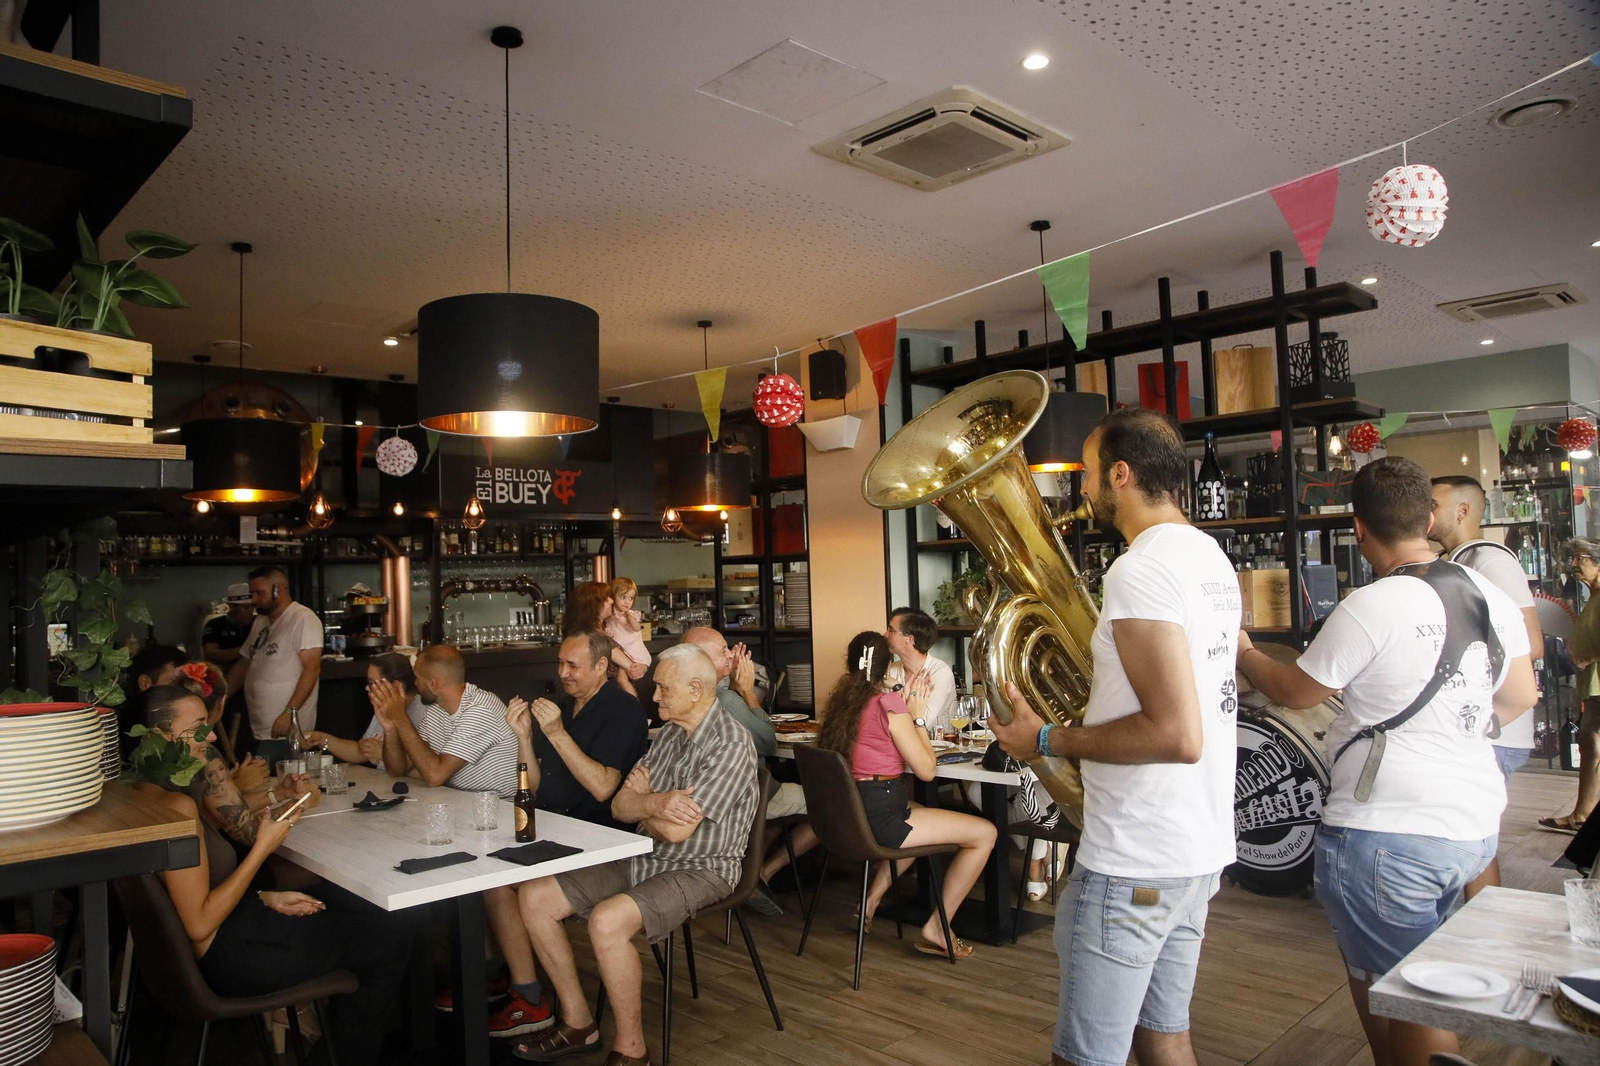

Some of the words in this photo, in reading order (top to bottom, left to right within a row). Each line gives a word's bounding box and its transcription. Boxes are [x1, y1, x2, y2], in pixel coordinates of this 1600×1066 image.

[475, 466, 492, 478] La
[495, 467, 552, 483] BELLOTA
[476, 479, 493, 504] El
[495, 482, 553, 505] BUEY
[1243, 846, 1252, 856] el
[1253, 848, 1277, 860] Show
[1277, 845, 1291, 859] del
[1287, 830, 1307, 853] Parro
